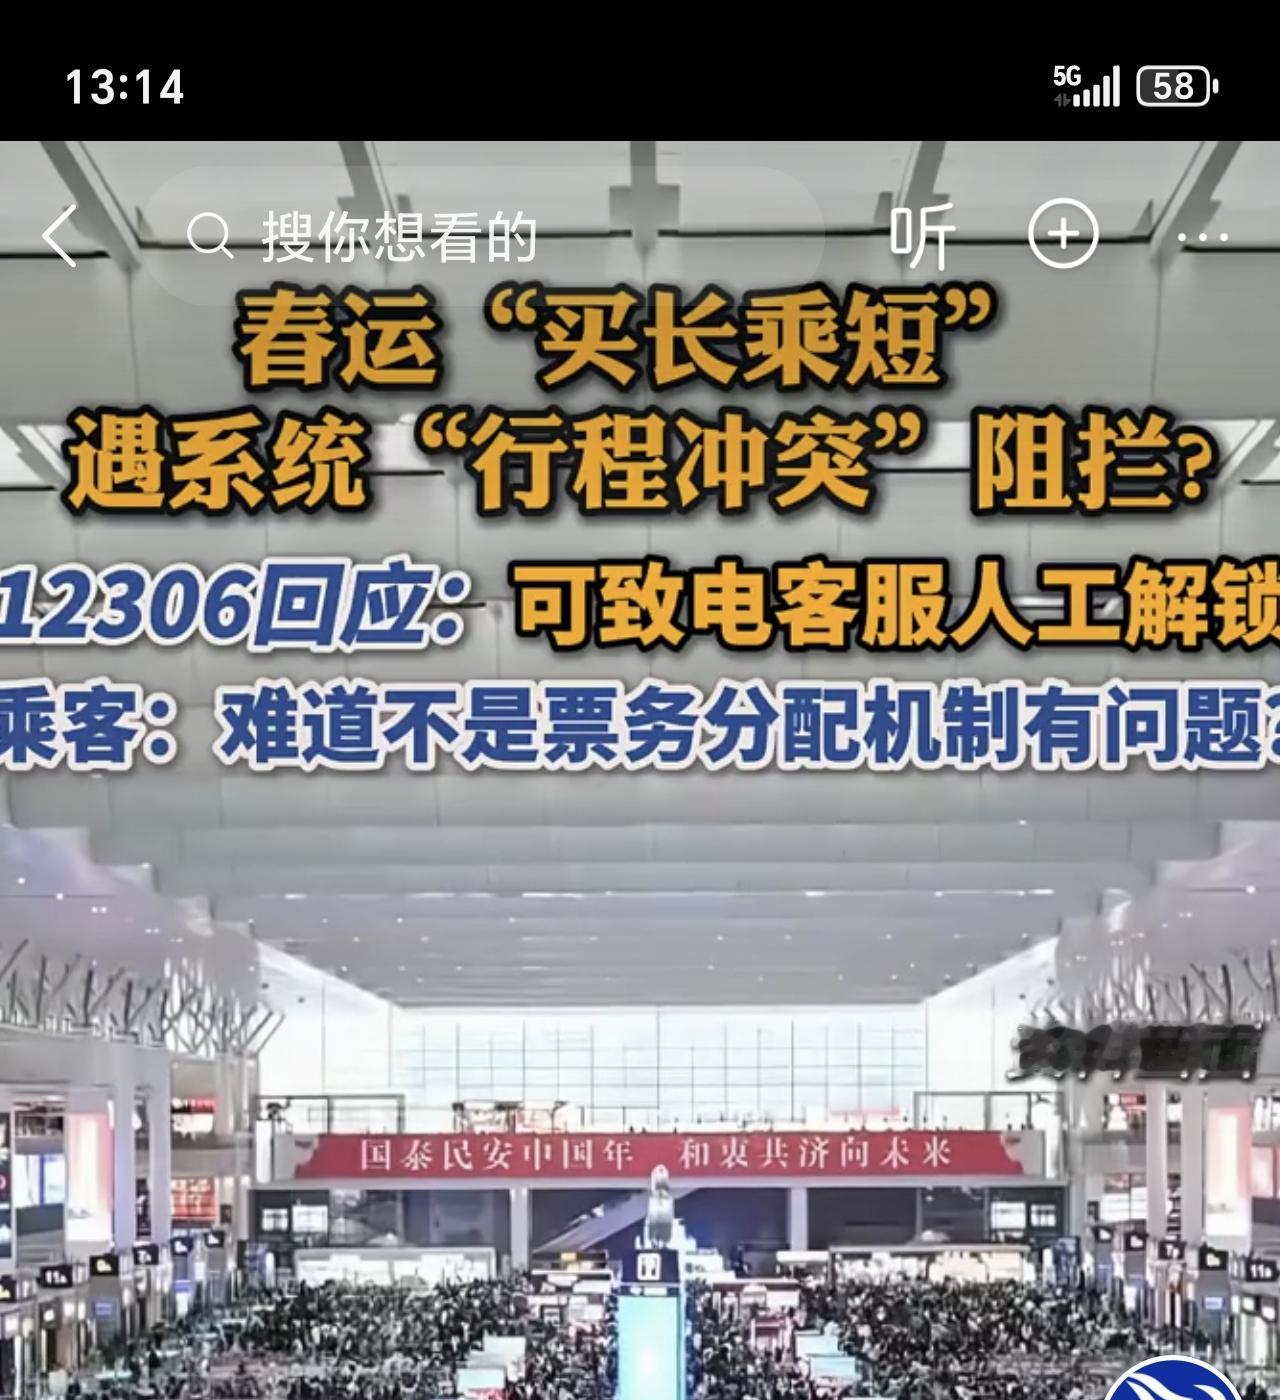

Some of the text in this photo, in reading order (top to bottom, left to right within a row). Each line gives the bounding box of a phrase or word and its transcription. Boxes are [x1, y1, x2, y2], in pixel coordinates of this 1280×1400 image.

[361, 1136, 951, 1171] 国泰民安中国年 和衷共济向未来
